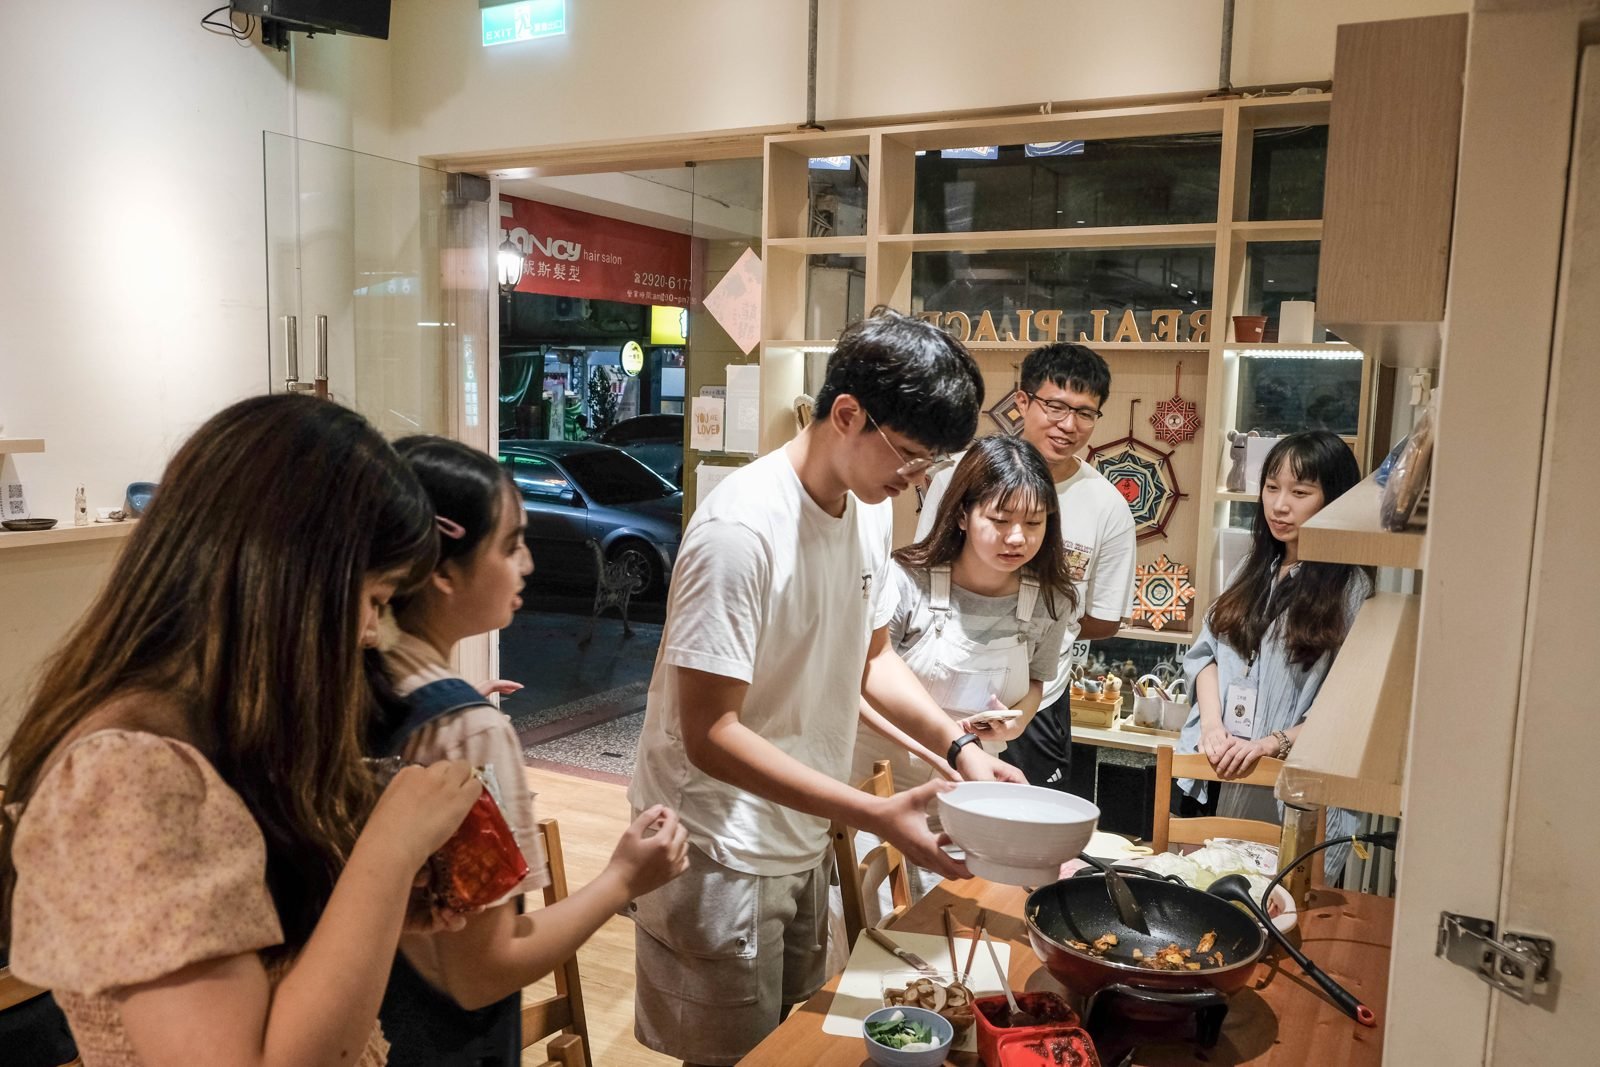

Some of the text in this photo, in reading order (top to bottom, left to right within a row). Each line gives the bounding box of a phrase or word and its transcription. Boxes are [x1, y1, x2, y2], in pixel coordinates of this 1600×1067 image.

[486, 28, 512, 41] EXIT
[583, 249, 623, 265] hair salon
[695, 411, 709, 423] YOU
[697, 423, 720, 435] LOVED
